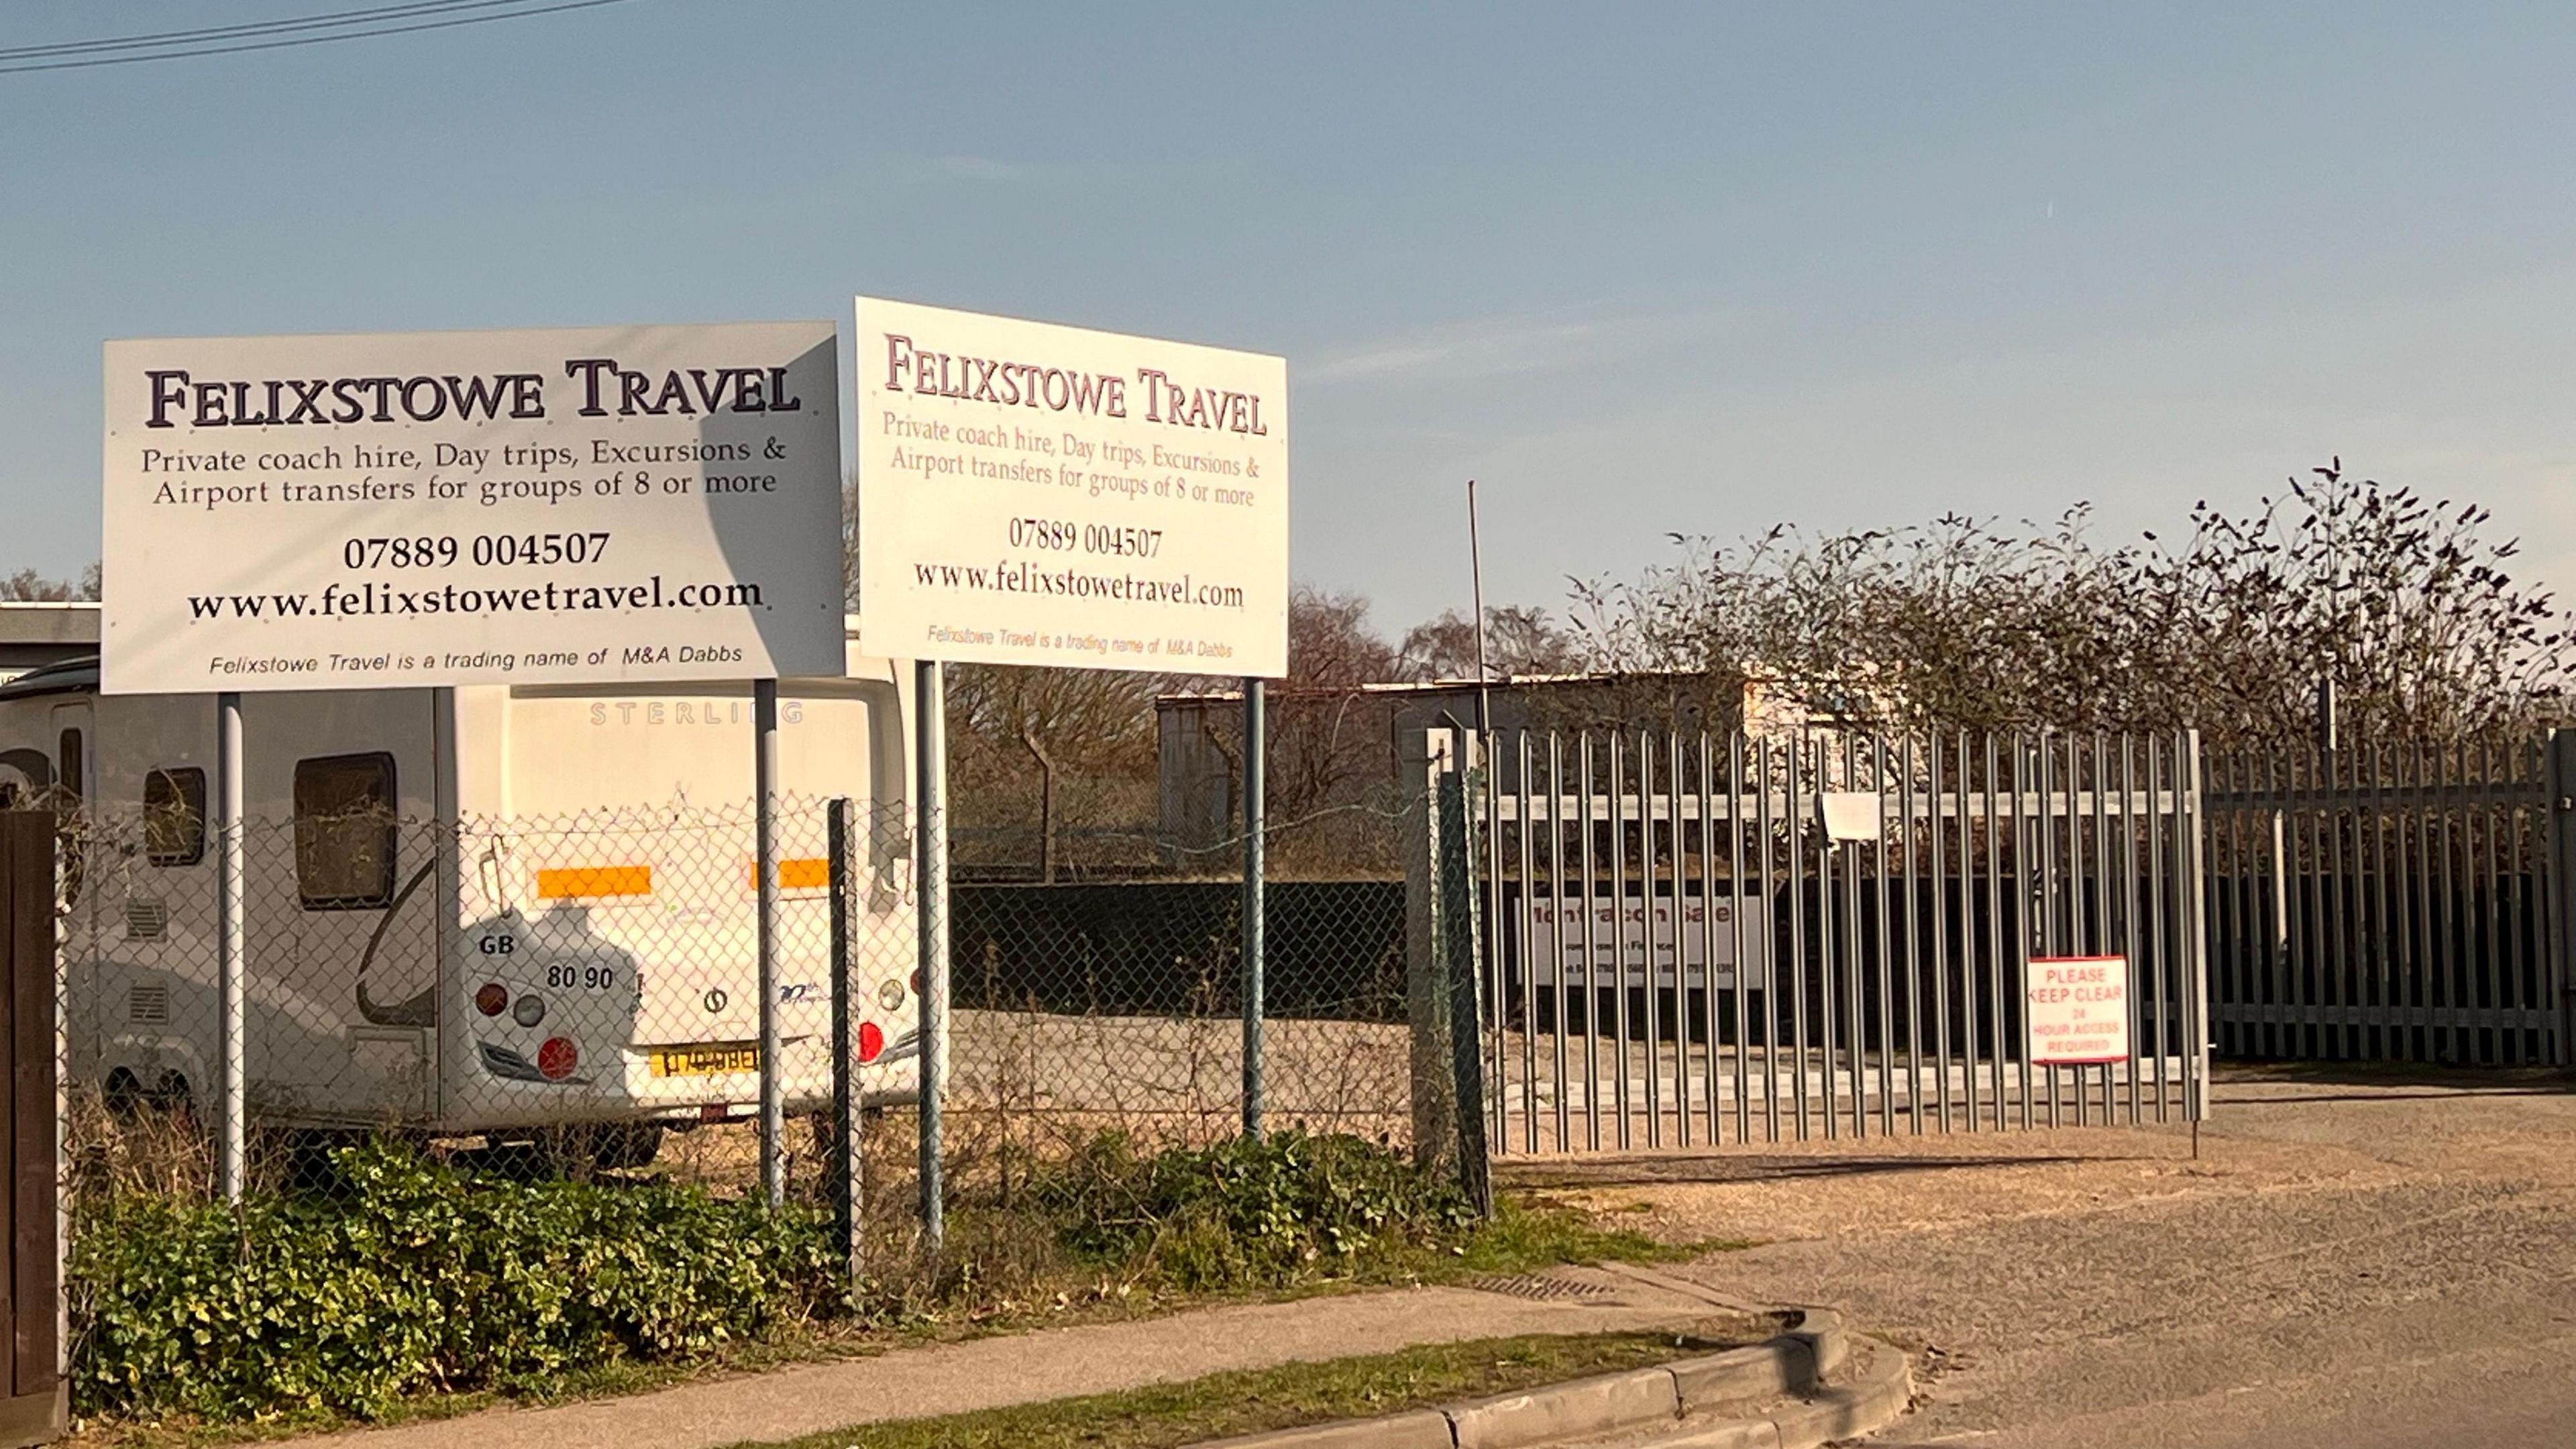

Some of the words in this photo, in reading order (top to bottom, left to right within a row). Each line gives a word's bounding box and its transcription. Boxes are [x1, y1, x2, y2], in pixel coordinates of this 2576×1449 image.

[145, 370, 545, 428] FELIXSTOWE
[566, 359, 800, 417] TRAVEL
[885, 334, 1126, 419] FELIXSTOWE
[1138, 368, 1267, 436] TRAVEL
[143, 449, 245, 472] Private
[259, 446, 341, 470] coach
[356, 445, 421, 470] hire,
[435, 443, 489, 474] Day
[504, 442, 578, 473] trips,
[592, 439, 750, 464] Excursions
[764, 436, 786, 459] &
[883, 411, 949, 441] Private
[957, 425, 1008, 448] coach
[1015, 427, 1055, 457] hire,
[1062, 433, 1095, 466] Day
[1103, 441, 1146, 468] trips,
[1153, 444, 1240, 478] Excursions
[1246, 457, 1259, 478] &
[154, 481, 268, 510] Airport
[283, 476, 415, 501] transfers
[429, 475, 467, 498] for
[480, 480, 581, 506] groups
[595, 472, 623, 495] of
[635, 471, 649, 494] 8
[663, 478, 692, 494] or
[706, 476, 775, 492] more
[891, 446, 963, 479] Airport
[972, 454, 1053, 484] transfers
[1059, 465, 1083, 487] for
[1089, 474, 1148, 500] groups
[1154, 476, 1171, 497] of
[1177, 477, 1186, 498] 8
[1192, 485, 1208, 502] or
[1215, 488, 1254, 506] more
[345, 537, 457, 568] 07889
[473, 533, 610, 566] 004507
[1010, 518, 1076, 550] 07889
[1085, 525, 1162, 557] 004507
[188, 576, 762, 619] www.felixstowetravel.com
[916, 560, 1242, 606] www.felixstowetravel.com
[928, 625, 994, 645] Felixstowe
[1000, 629, 1036, 647] Travel
[1040, 632, 1051, 647] is
[1055, 636, 1062, 649] a
[1067, 634, 1108, 655] trading
[1112, 639, 1143, 653] name
[1148, 638, 1160, 654] of
[1167, 639, 1193, 655] M&A
[1197, 641, 1232, 657] Dabbs
[210, 657, 317, 674] Felixstowe
[330, 653, 390, 670] Travel
[397, 653, 413, 669] is
[423, 656, 435, 668] a
[445, 652, 515, 671] trading
[524, 653, 578, 665] name
[588, 649, 608, 665] of
[623, 647, 669, 664] M&A
[680, 645, 741, 662] Dabbs
[590, 702, 803, 726] STERLIG
[480, 935, 514, 955] GB
[547, 965, 576, 989] 80
[584, 967, 613, 989] 90
[2046, 967, 2107, 984] PLEASE
[2028, 988, 2070, 1004] KEEP
[2074, 985, 2123, 1002] CLEAR
[2033, 1024, 2070, 1036] HOUR
[2074, 1022, 2120, 1035] ACCESS
[2072, 1008, 2086, 1020] 24
[2047, 1039, 2110, 1053] REQUIRED
